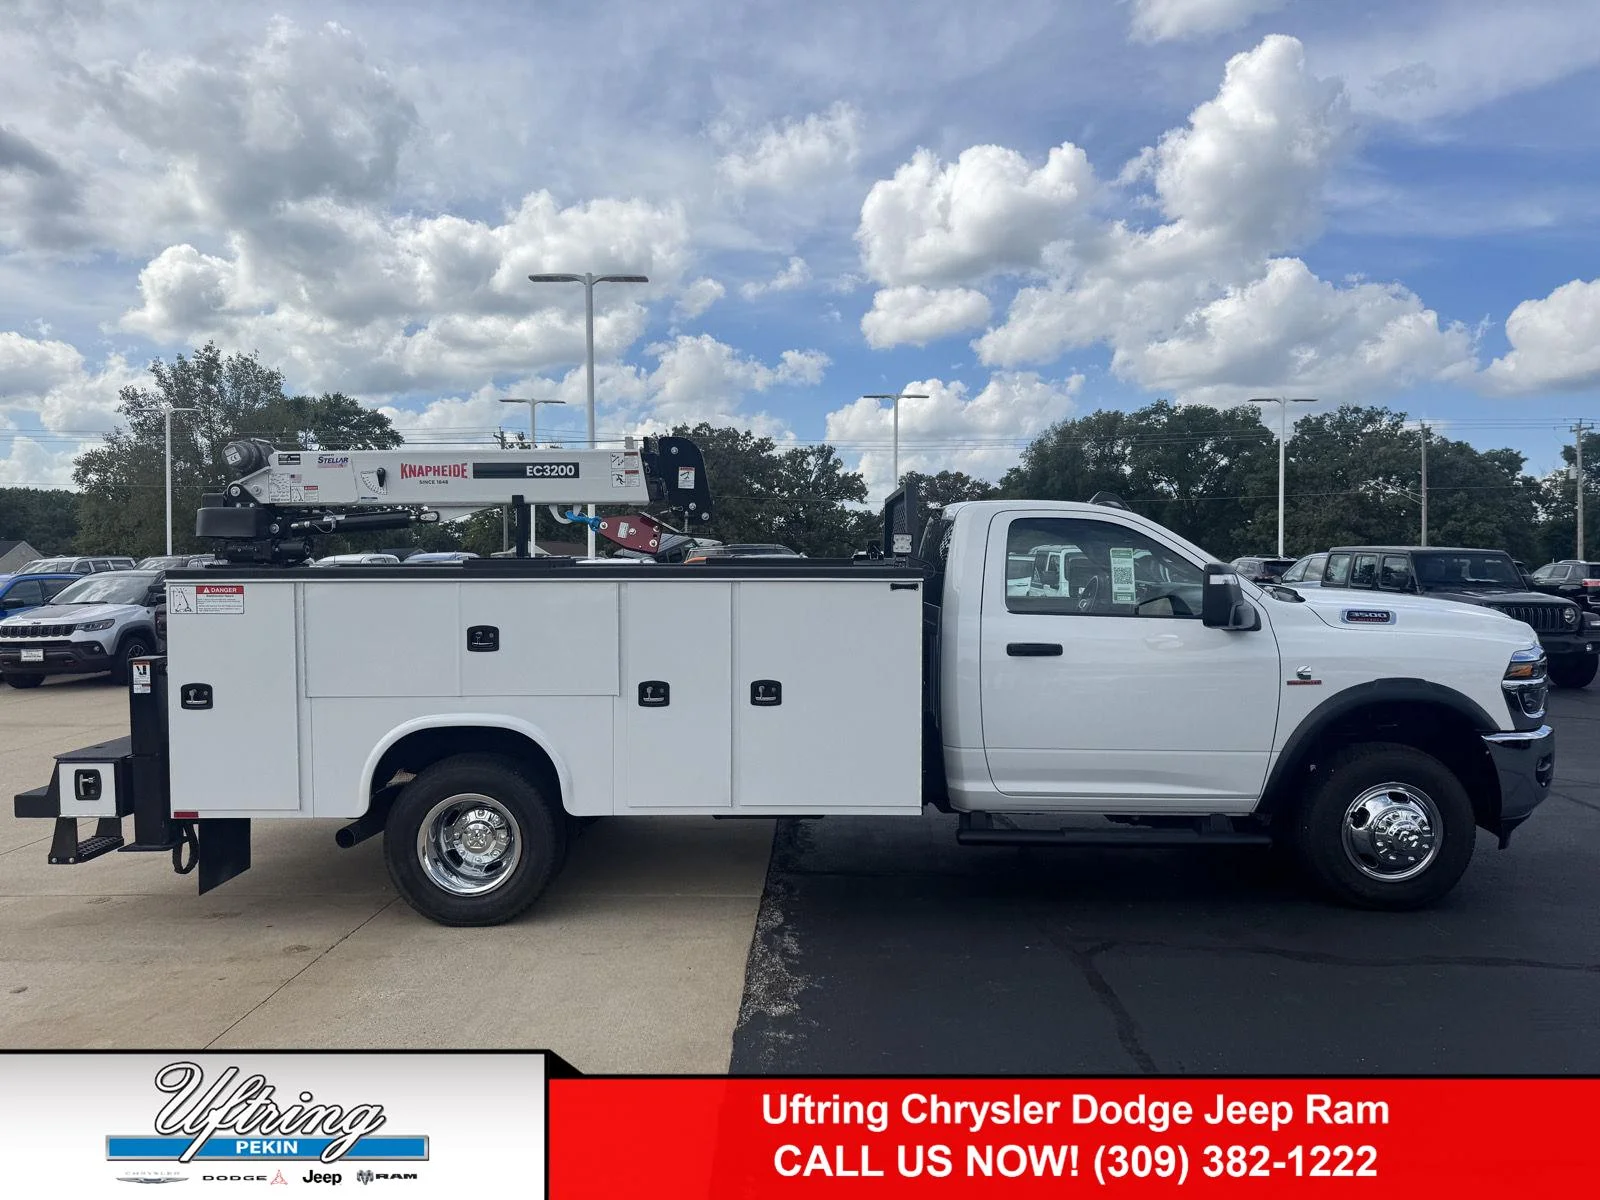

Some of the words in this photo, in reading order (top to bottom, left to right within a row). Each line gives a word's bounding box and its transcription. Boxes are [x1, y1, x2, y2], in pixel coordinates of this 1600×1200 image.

[317, 456, 349, 464] STELLAR
[400, 463, 468, 479] KNAPHEIDE
[526, 465, 575, 476] EC3200
